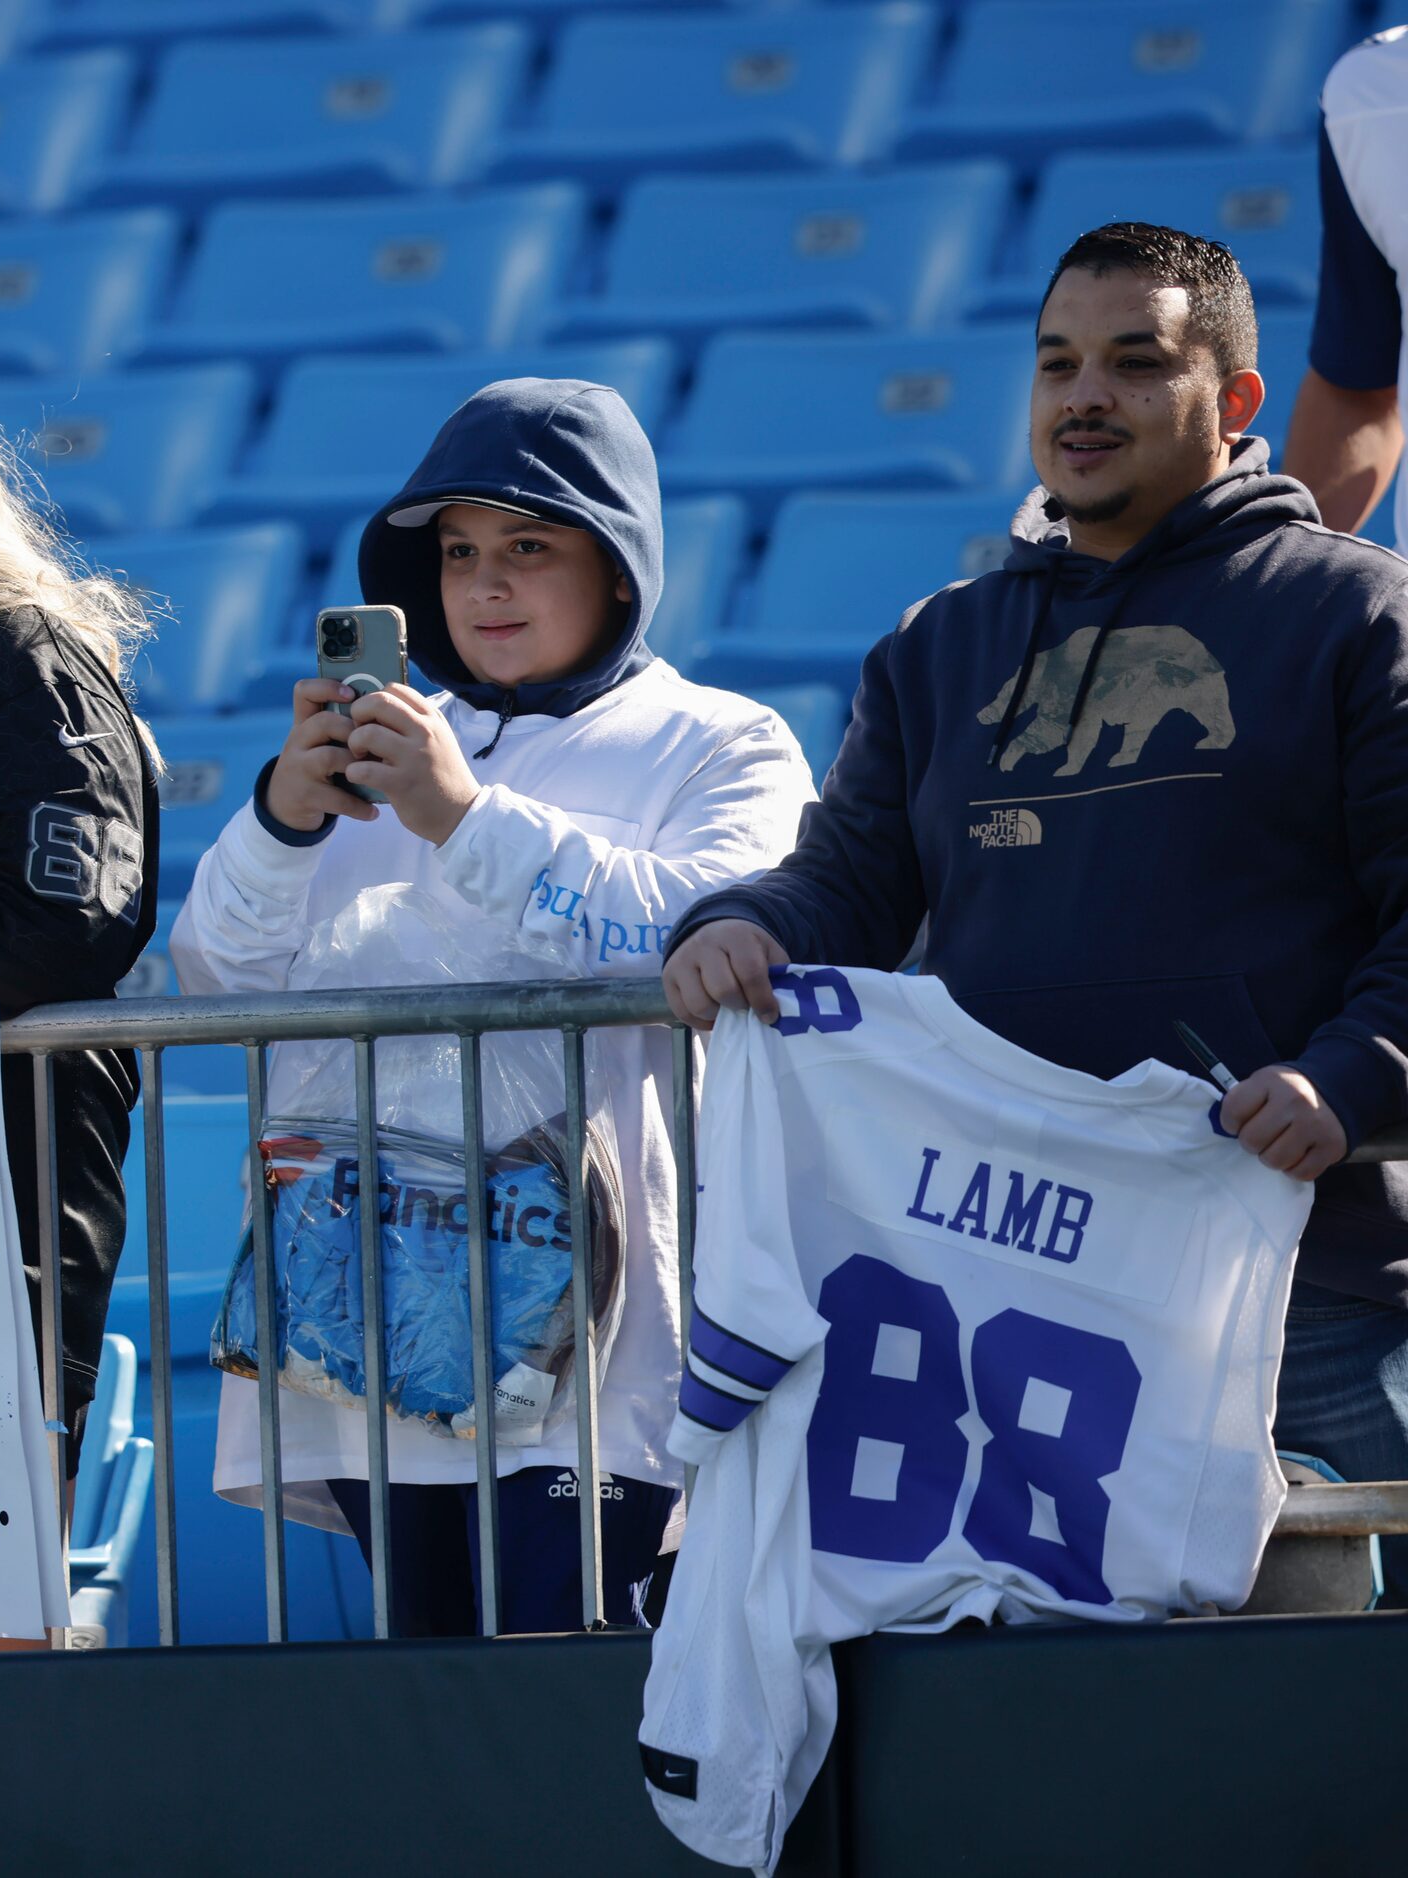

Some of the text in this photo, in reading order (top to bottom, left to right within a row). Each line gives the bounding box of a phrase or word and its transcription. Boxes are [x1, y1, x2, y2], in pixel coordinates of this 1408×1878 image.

[968, 822, 1017, 839] NORTH
[980, 834, 1017, 849] FACE
[990, 808, 1018, 823] THE
[25, 802, 144, 926] 88
[906, 1146, 1094, 1265] LAMB
[805, 1253, 1143, 1607] 88
